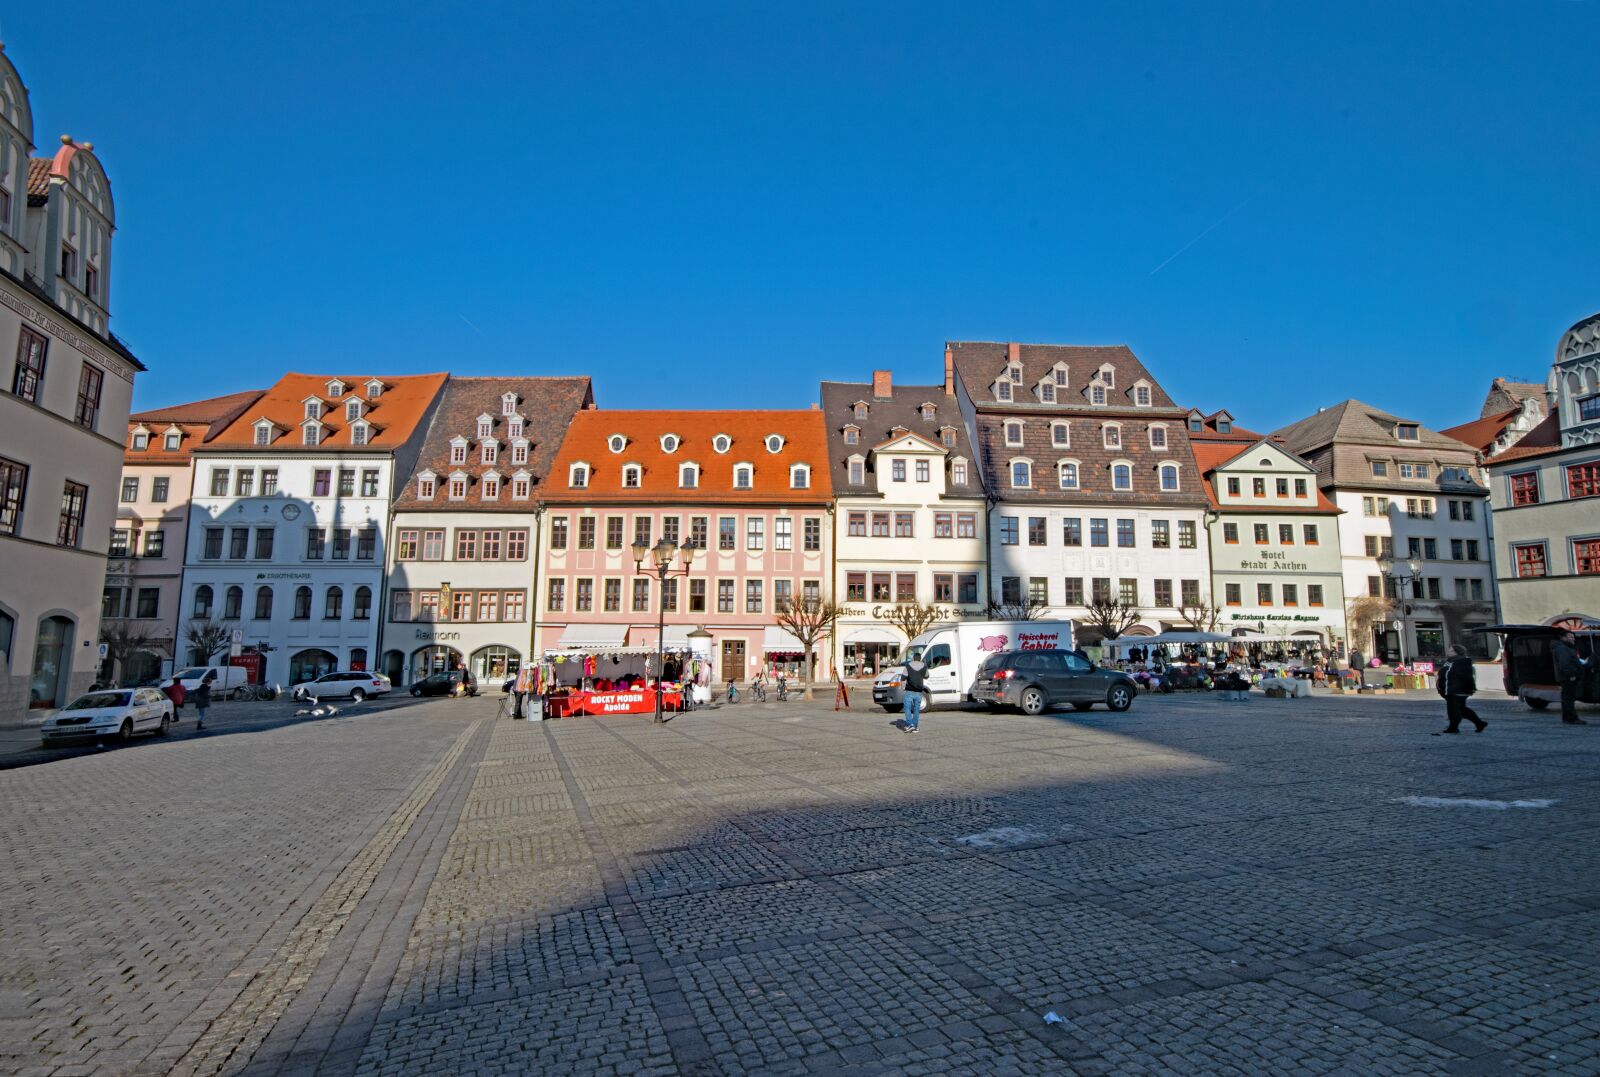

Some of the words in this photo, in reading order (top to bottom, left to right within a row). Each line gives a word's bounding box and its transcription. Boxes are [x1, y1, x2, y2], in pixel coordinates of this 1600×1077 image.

[1260, 551, 1285, 560] Hotel
[1240, 560, 1268, 569] Stadt
[1273, 561, 1307, 570] Aachen
[1018, 632, 1059, 641] Fleischerei
[1021, 640, 1058, 650] Gabler
[591, 695, 615, 704] ROCKY
[616, 694, 643, 703] MODEN
[604, 702, 630, 712] Apolda
